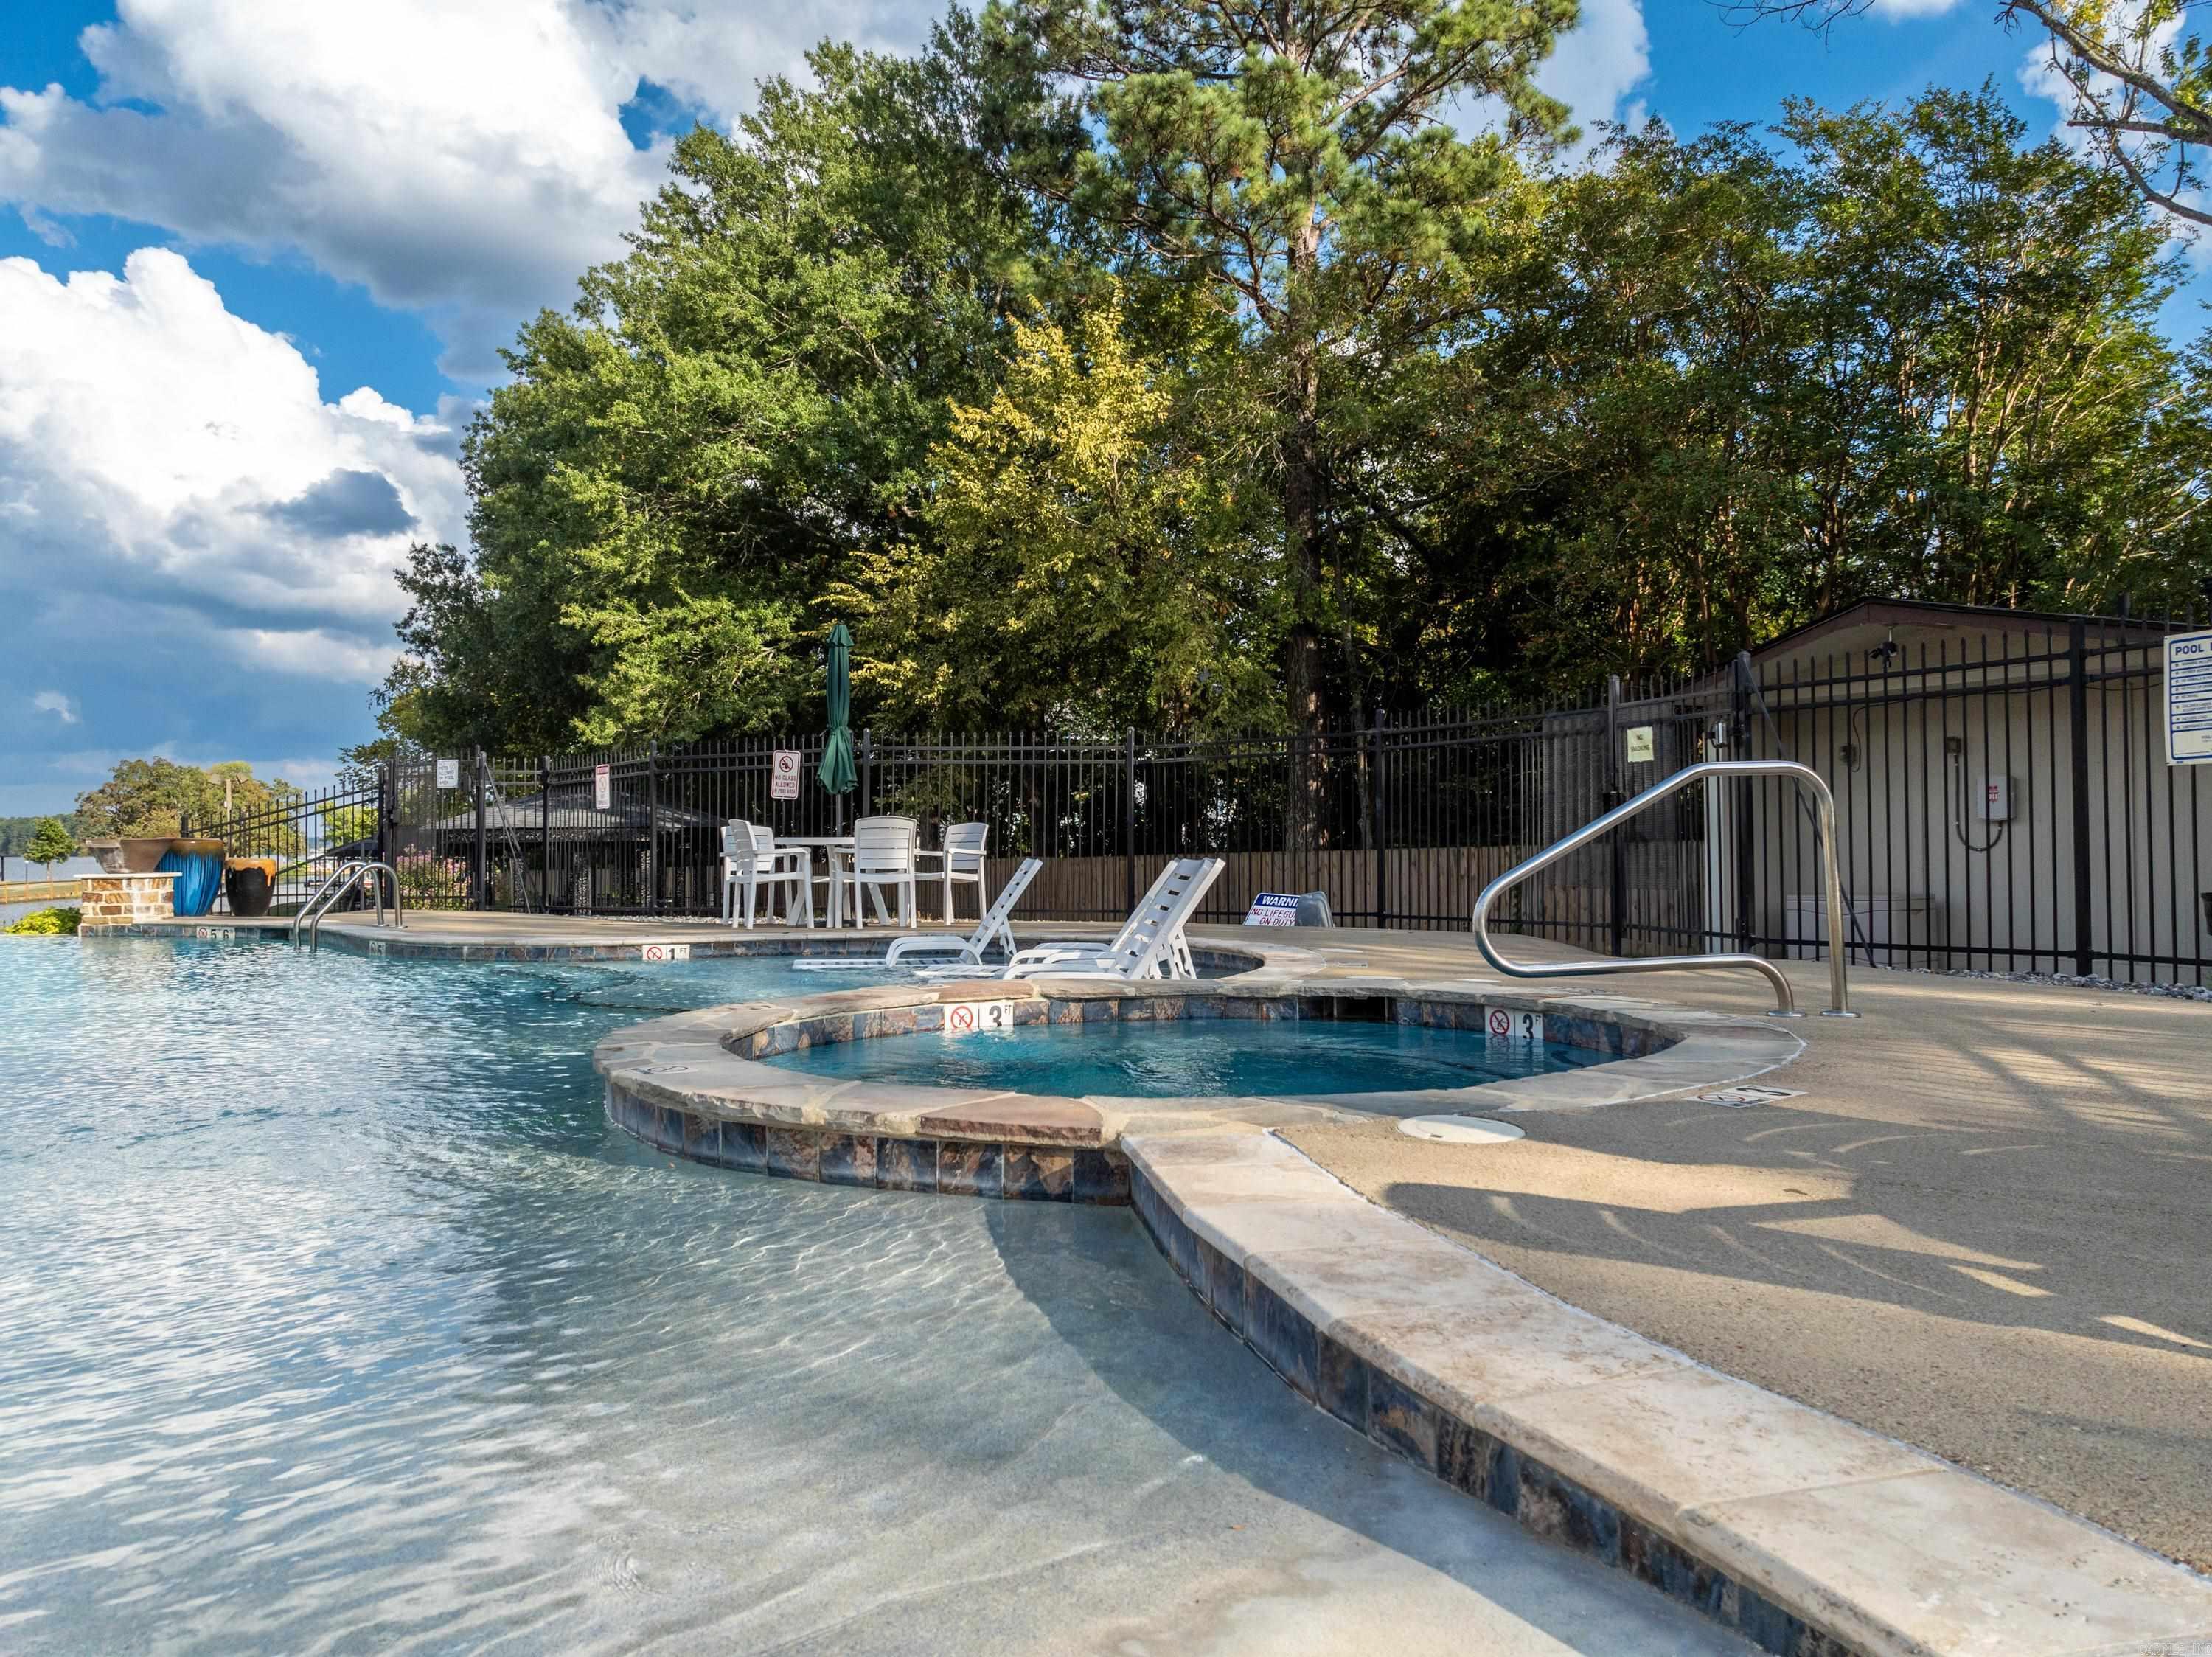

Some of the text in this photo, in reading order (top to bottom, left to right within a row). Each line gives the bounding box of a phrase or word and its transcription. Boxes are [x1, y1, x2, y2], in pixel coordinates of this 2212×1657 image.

[2176, 643, 2204, 655] POOL
[1262, 896, 1298, 907] WARNI
[1265, 909, 1296, 919] LIFEGU
[1259, 917, 1297, 926] ON DUTY
[211, 928, 217, 938] 5
[669, 948, 675, 959] 1
[989, 1004, 1012, 1027] 3 FT
[1522, 1013, 1534, 1039] 3
